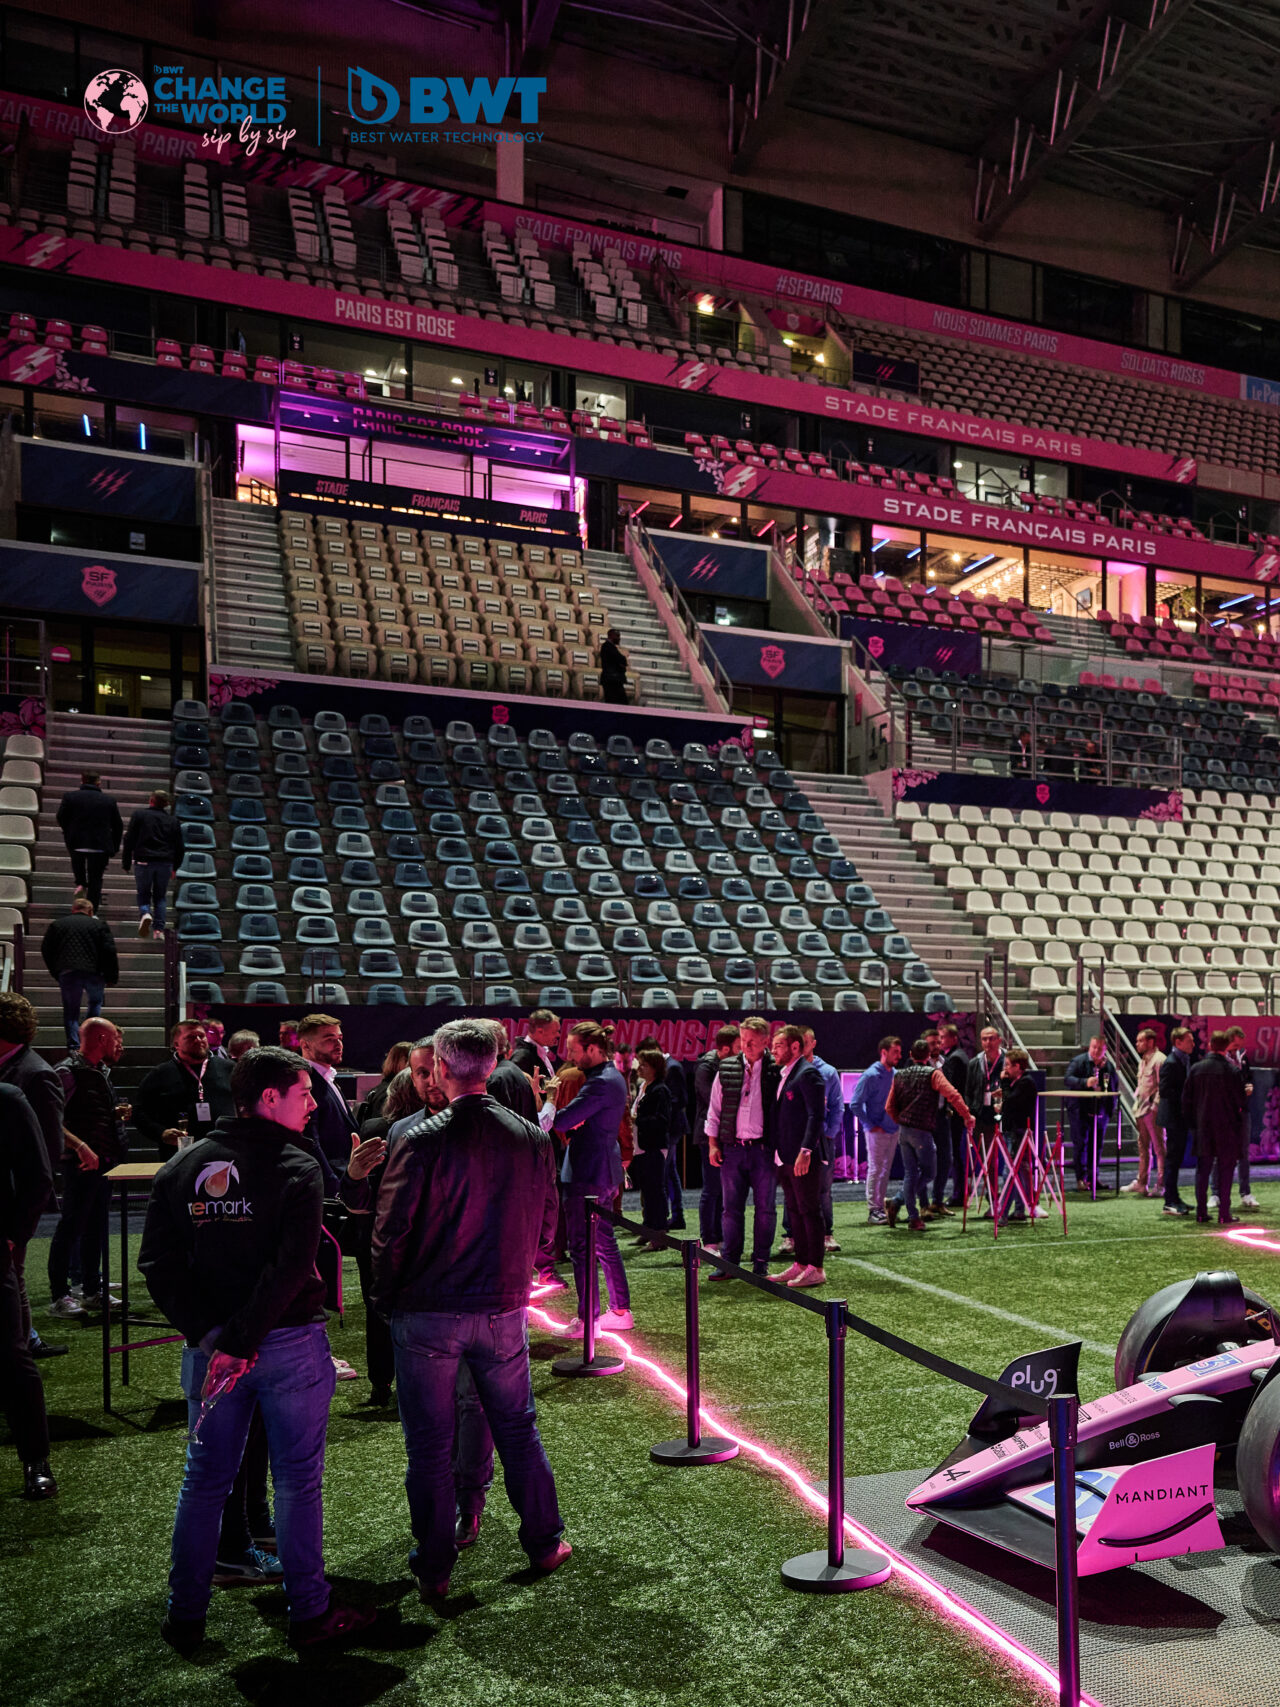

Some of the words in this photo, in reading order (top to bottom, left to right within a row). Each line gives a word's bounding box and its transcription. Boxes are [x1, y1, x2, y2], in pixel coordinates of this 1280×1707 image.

[142, 131, 198, 159] PARIS
[776, 274, 843, 305] #SFPARIS
[335, 297, 382, 325] PARIS
[384, 307, 413, 331] EST
[416, 313, 456, 339] ROSE
[932, 310, 967, 333] NOUS
[968, 317, 1021, 346] SOMMES
[1023, 330, 1059, 353] PARIS
[1121, 351, 1169, 378] SOLDATS
[1170, 363, 1206, 386] ROSES
[825, 396, 899, 421] STADE
[907, 412, 1016, 443] FRANÇAIS
[1022, 433, 1082, 457] PARIS
[316, 479, 349, 497] STADE
[519, 508, 549, 525] PARIS
[883, 498, 963, 525] STADE
[970, 513, 1086, 544] FRANÇAIS
[1092, 534, 1157, 556] PARIS
[187, 1196, 254, 1216] remark
[1108, 1439, 1125, 1451] Bell
[1140, 1431, 1161, 1442] Ross
[1115, 1484, 1209, 1505] MANDIANT
